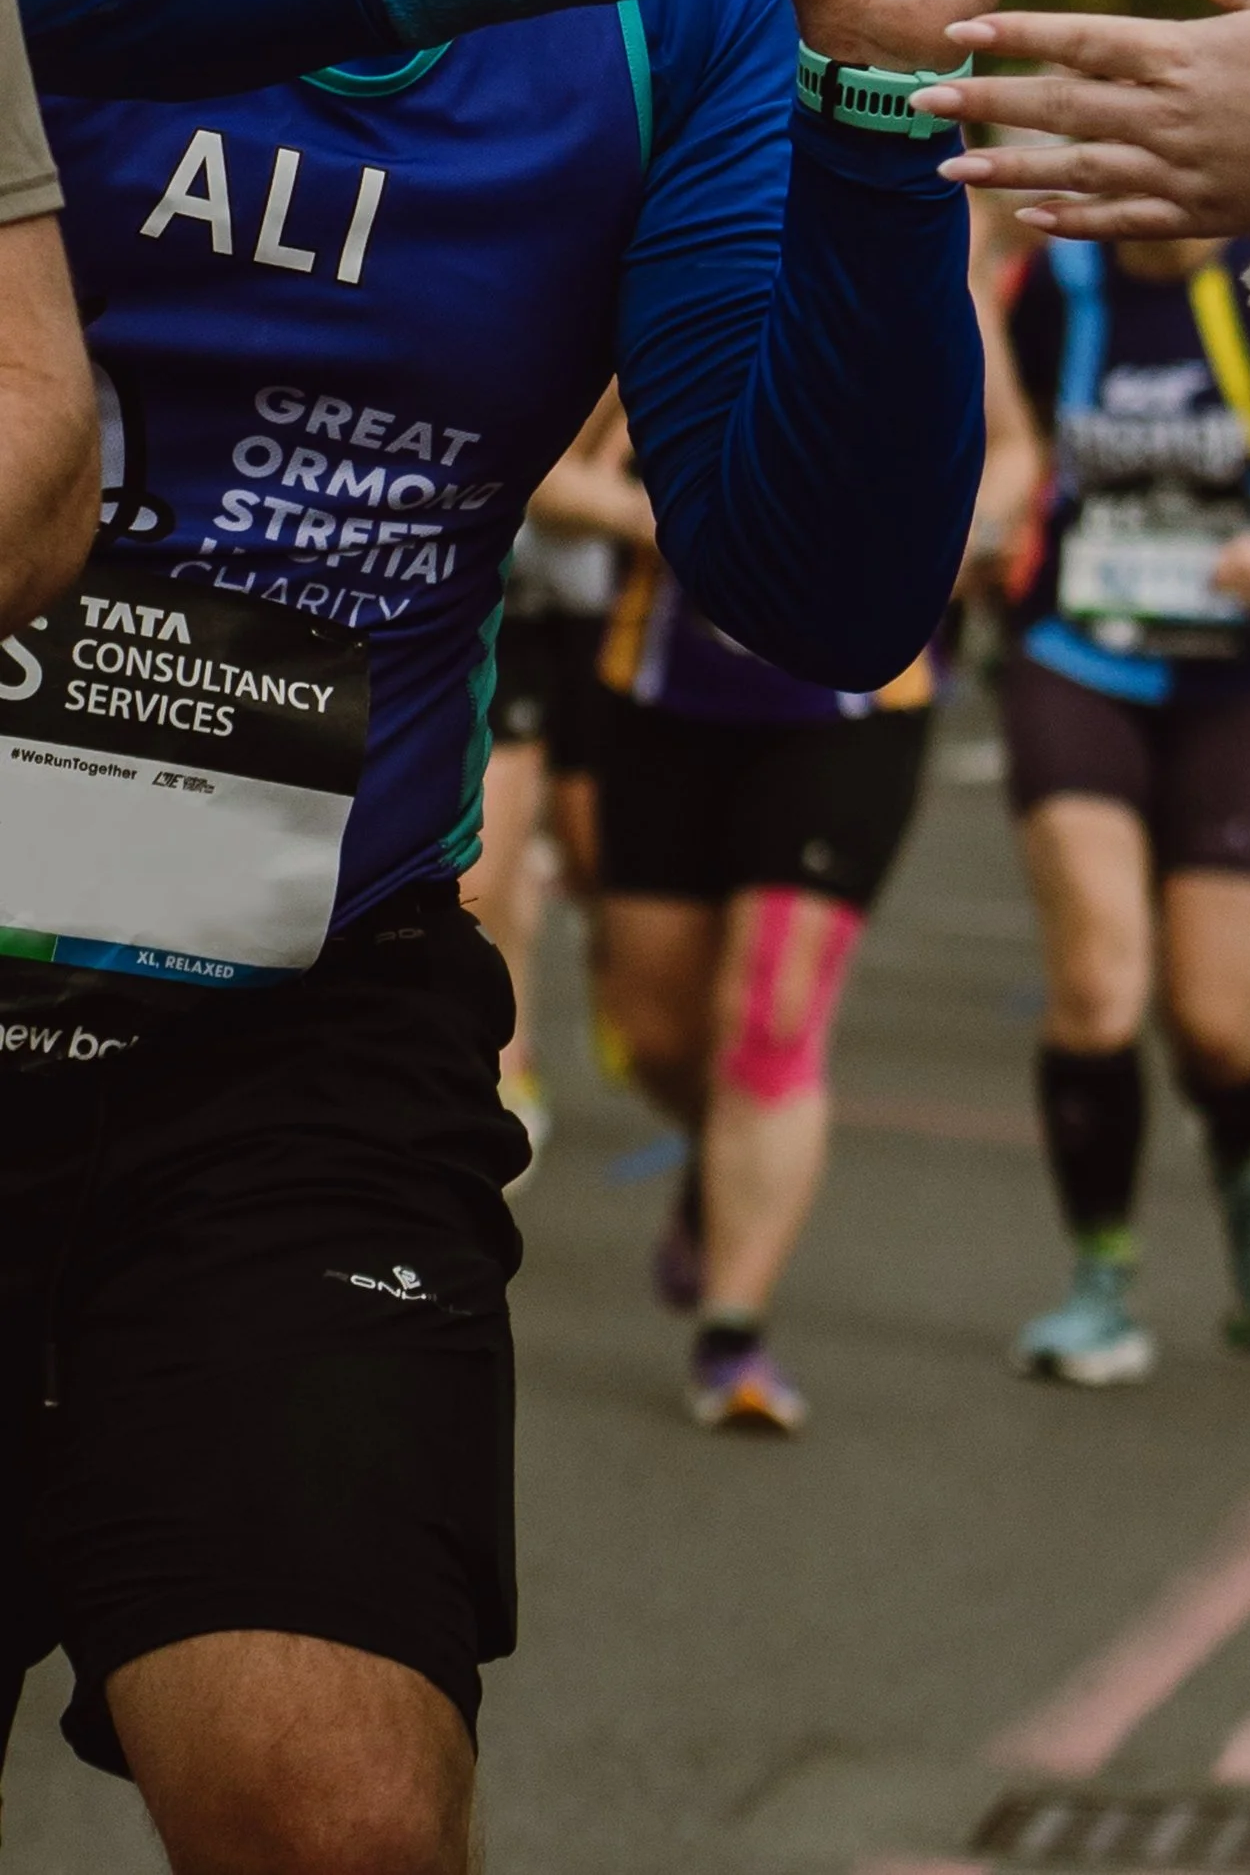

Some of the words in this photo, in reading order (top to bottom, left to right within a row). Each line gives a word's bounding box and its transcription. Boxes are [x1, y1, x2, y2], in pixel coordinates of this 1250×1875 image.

[139, 128, 387, 285] ALI
[254, 384, 482, 468] GREAT
[231, 434, 505, 511] ORMOND
[80, 595, 192, 645] TATA
[64, 680, 235, 738] SERVICES
[71, 638, 336, 715] CONSULTANCY
[11, 747, 138, 781] #WeRunTogether
[136, 950, 160, 970] XL,
[164, 955, 235, 980] RELAXED
